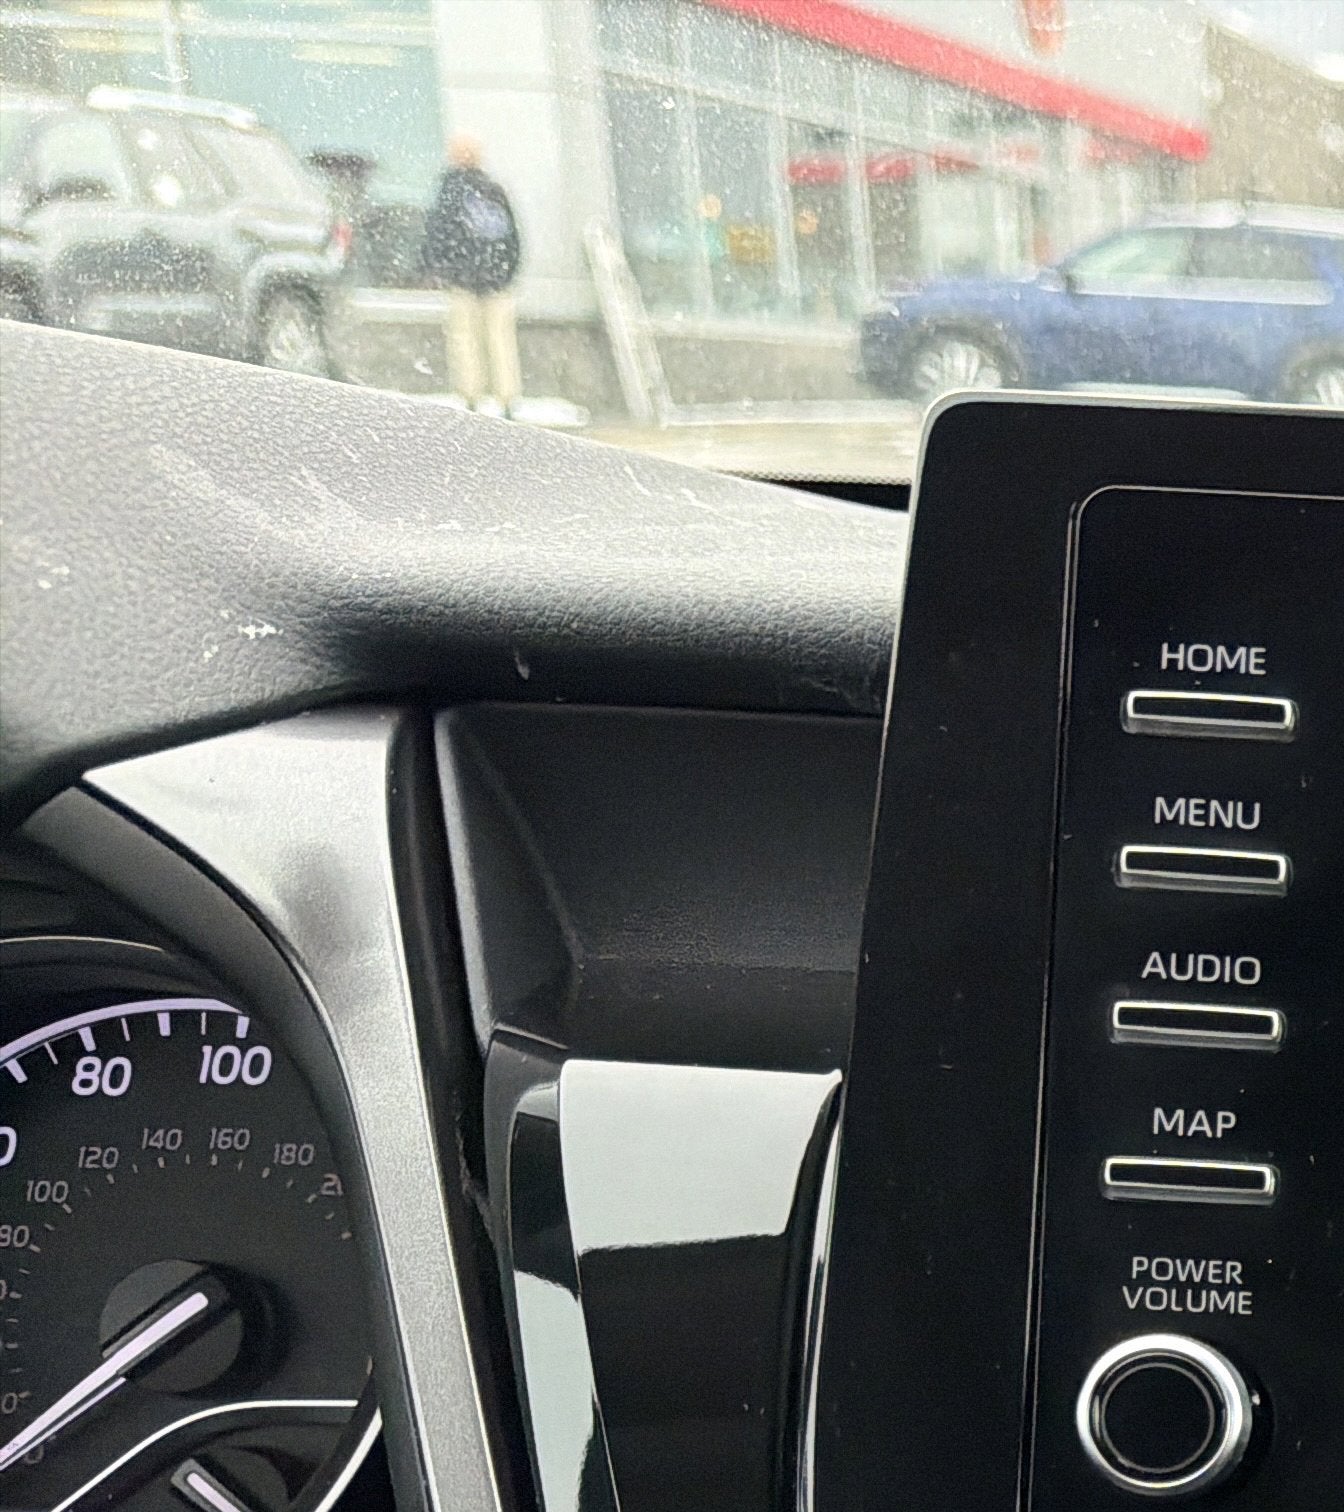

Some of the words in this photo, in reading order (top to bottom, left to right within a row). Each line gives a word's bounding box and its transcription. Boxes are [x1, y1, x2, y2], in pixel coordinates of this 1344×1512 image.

[1160, 643, 1267, 675] HOME
[1154, 797, 1261, 829] MENU
[1141, 951, 1262, 985] AUDIO
[71, 1056, 132, 1097] 80
[199, 1045, 272, 1086] 100
[1152, 1107, 1238, 1139] MAP
[141, 1128, 183, 1152] 140
[209, 1127, 251, 1152] 160
[78, 1146, 119, 1170] 120
[273, 1143, 315, 1167] 180
[26, 1180, 69, 1204] 100
[1131, 1257, 1243, 1285] POWER
[1122, 1286, 1253, 1315] VOLUME
